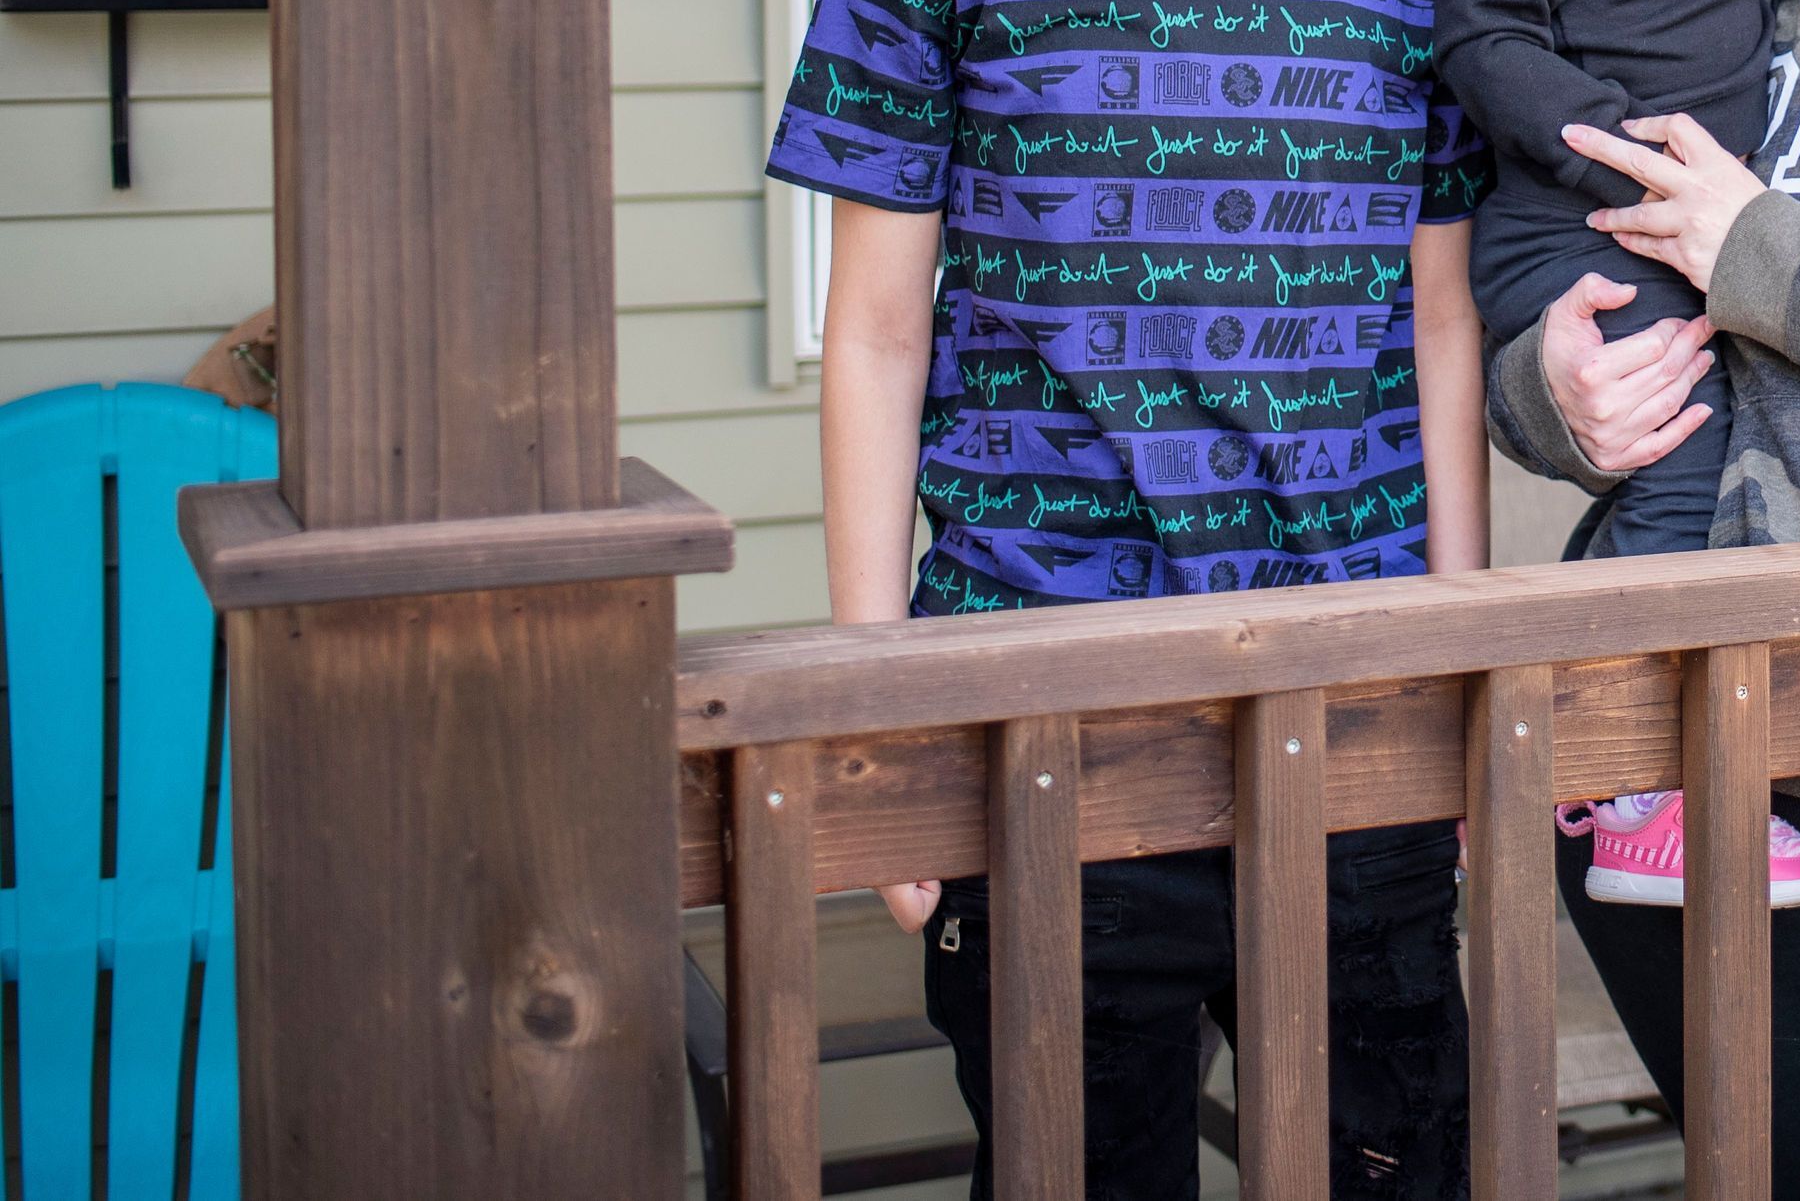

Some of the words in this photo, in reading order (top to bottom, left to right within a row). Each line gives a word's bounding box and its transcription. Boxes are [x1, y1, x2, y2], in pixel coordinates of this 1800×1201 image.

[996, 11, 1064, 56] Just
[1149, 0, 1205, 50] Just
[1278, 5, 1346, 58] Just
[825, 62, 885, 117] Just
[1153, 60, 1212, 107] FORCE
[1268, 65, 1355, 111] NIKE
[1007, 124, 1064, 175] Just
[1145, 125, 1204, 176] Just
[1279, 126, 1339, 180] Just
[1145, 186, 1205, 233] FORCE
[1015, 248, 1059, 303] Just
[1136, 251, 1195, 303] Just
[1267, 253, 1325, 307] Just
[1138, 312, 1198, 360] FORCE
[1134, 378, 1189, 430] Just
[1142, 438, 1199, 486] FORCE
[962, 481, 1021, 524] Just
[1027, 482, 1091, 528] Just
